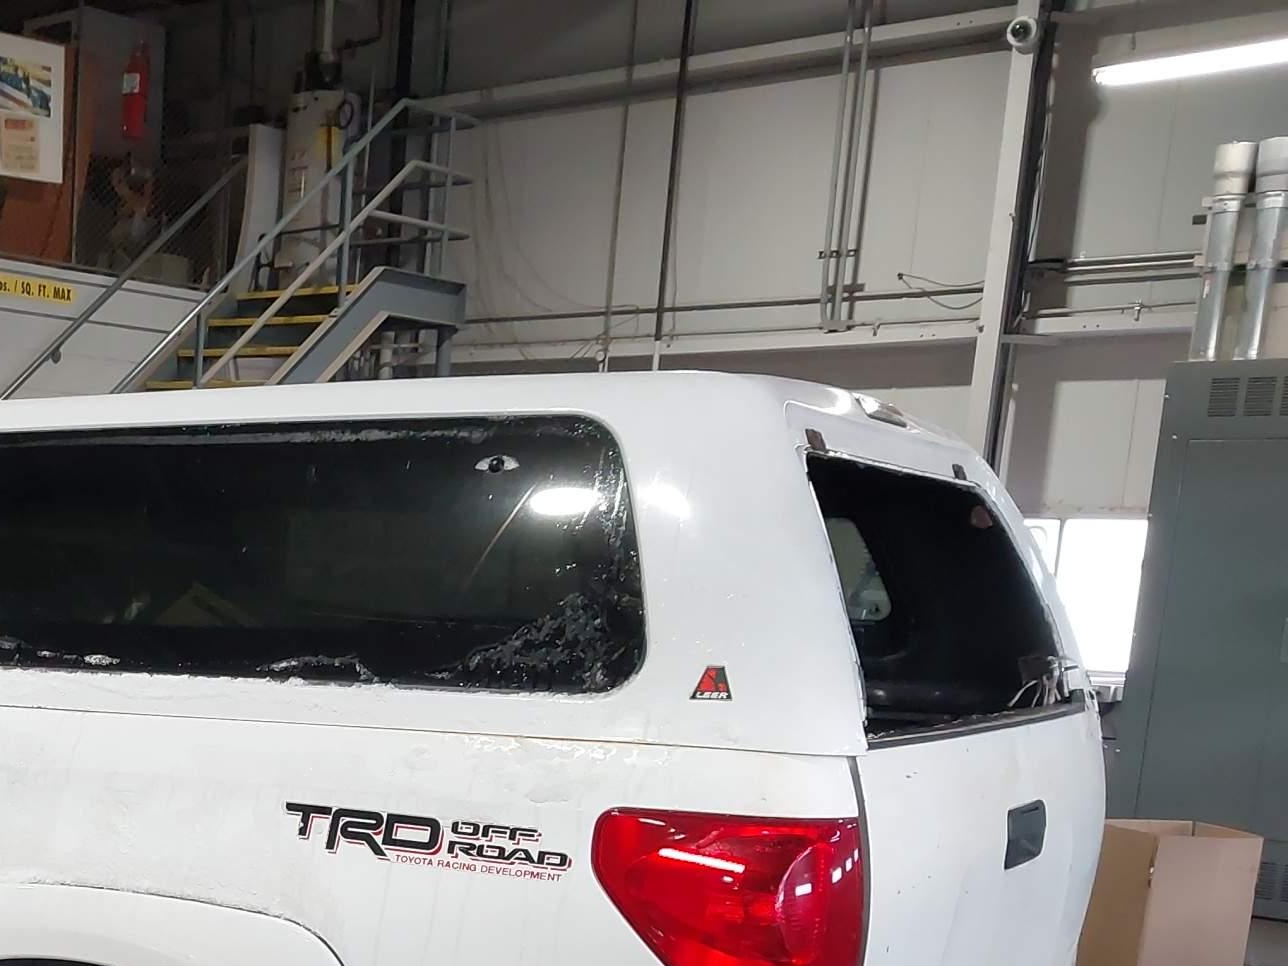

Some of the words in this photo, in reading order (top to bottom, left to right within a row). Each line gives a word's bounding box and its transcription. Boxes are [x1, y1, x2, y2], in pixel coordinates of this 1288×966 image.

[14, 279, 18, 293] /
[21, 281, 34, 296] SQ.
[38, 283, 50, 298] FT.
[53, 286, 72, 301] MAX
[695, 691, 730, 699] LEER
[285, 801, 444, 861] TRD
[451, 820, 542, 844] OFF
[395, 854, 433, 867] TOYOTA
[437, 859, 477, 873] RACING
[480, 864, 563, 882] DEVELOPMENT
[447, 840, 572, 871] ROAD
